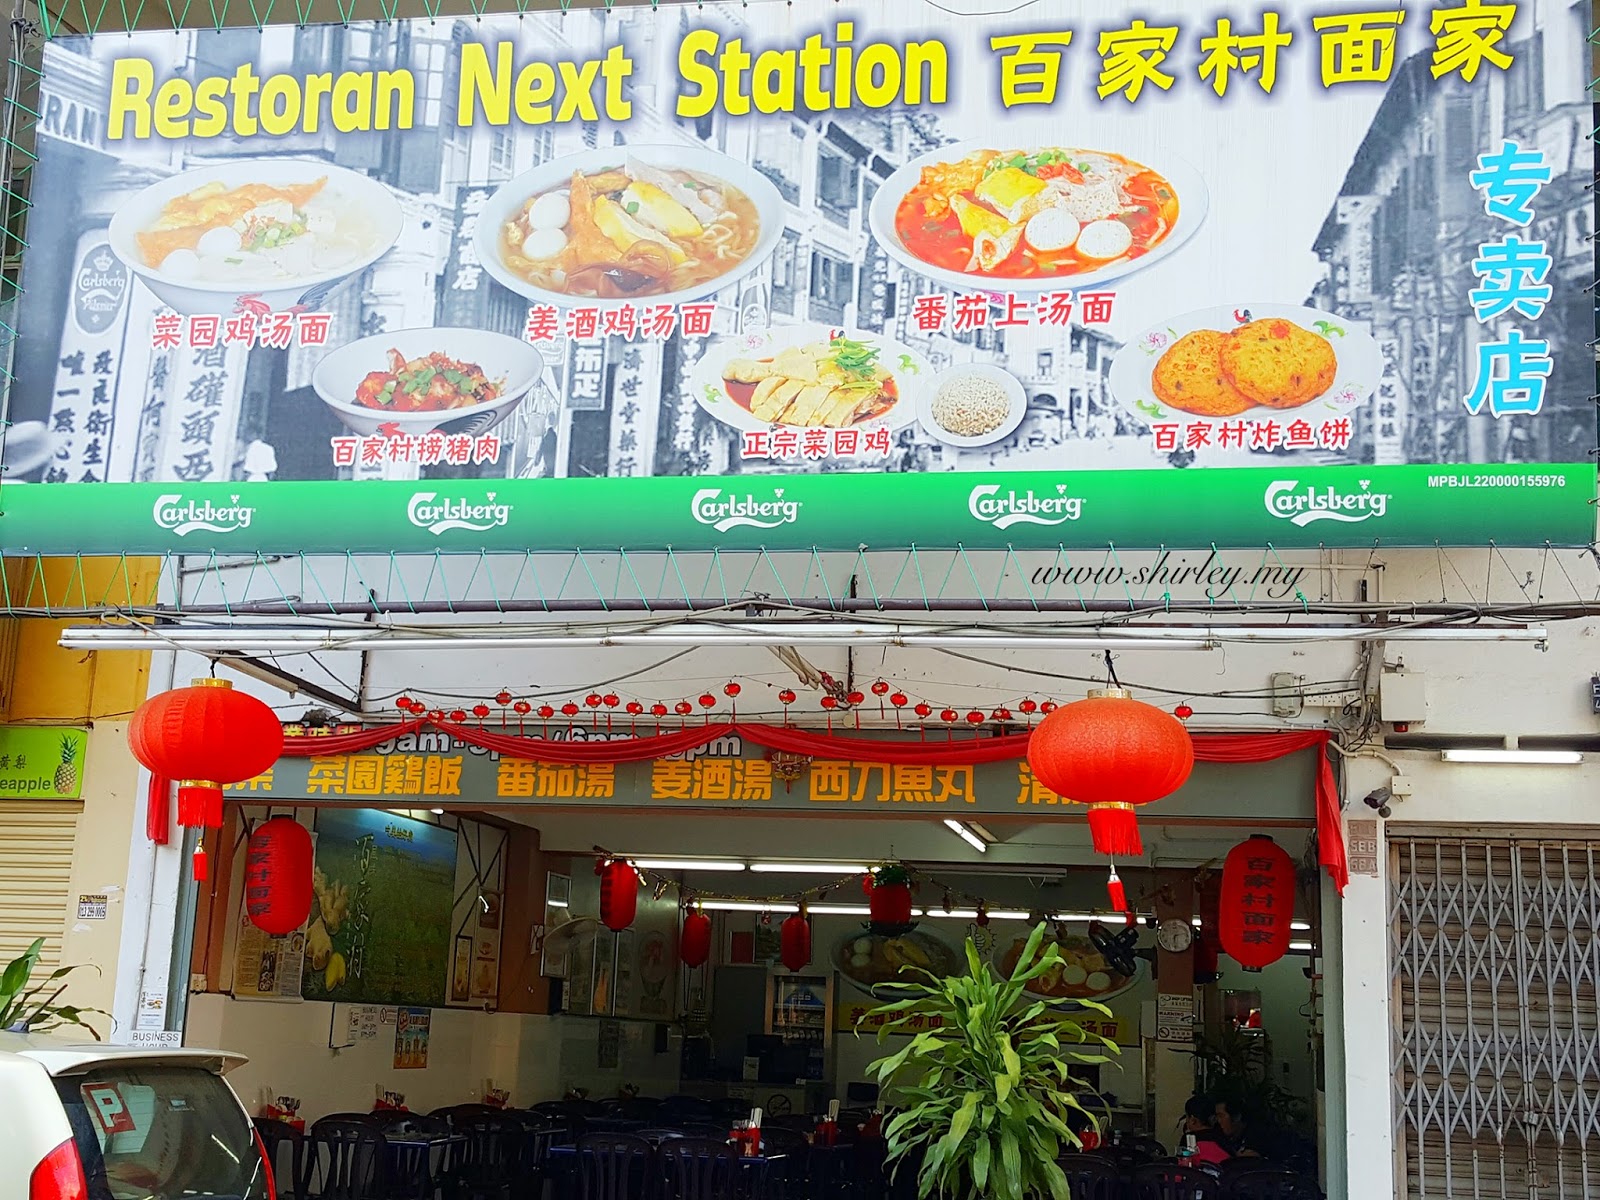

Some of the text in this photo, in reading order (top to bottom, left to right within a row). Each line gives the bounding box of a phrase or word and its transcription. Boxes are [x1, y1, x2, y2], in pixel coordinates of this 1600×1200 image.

[990, 0, 1517, 108] 百家村面家
[109, 21, 948, 140] Restoran Next Station
[79, 268, 125, 300] Carlsberg
[1468, 142, 1551, 415] 专卖店
[153, 314, 331, 348] 菜园鸡汤面
[527, 304, 716, 341] 姜酒鸡汤面
[913, 292, 1117, 330] 番茄上汤面
[333, 435, 499, 465] 百家村捞猪肉
[742, 427, 891, 458] 正宗菜园鸡
[1152, 418, 1351, 450] 百家村炸鱼饼
[1427, 474, 1566, 489] MPBJL220000155976
[153, 494, 254, 536] Carlsberg
[407, 492, 509, 536] Carlsberg
[691, 488, 799, 533] Carlsberg
[968, 484, 1083, 530] Carlsberg
[1264, 480, 1387, 527] Carlsberg
[651, 758, 772, 800] 姜酒湯
[809, 760, 976, 803] 西刀魚丸
[132, 1032, 179, 1042] BUSINESS
[90, 1088, 124, 1128] P
